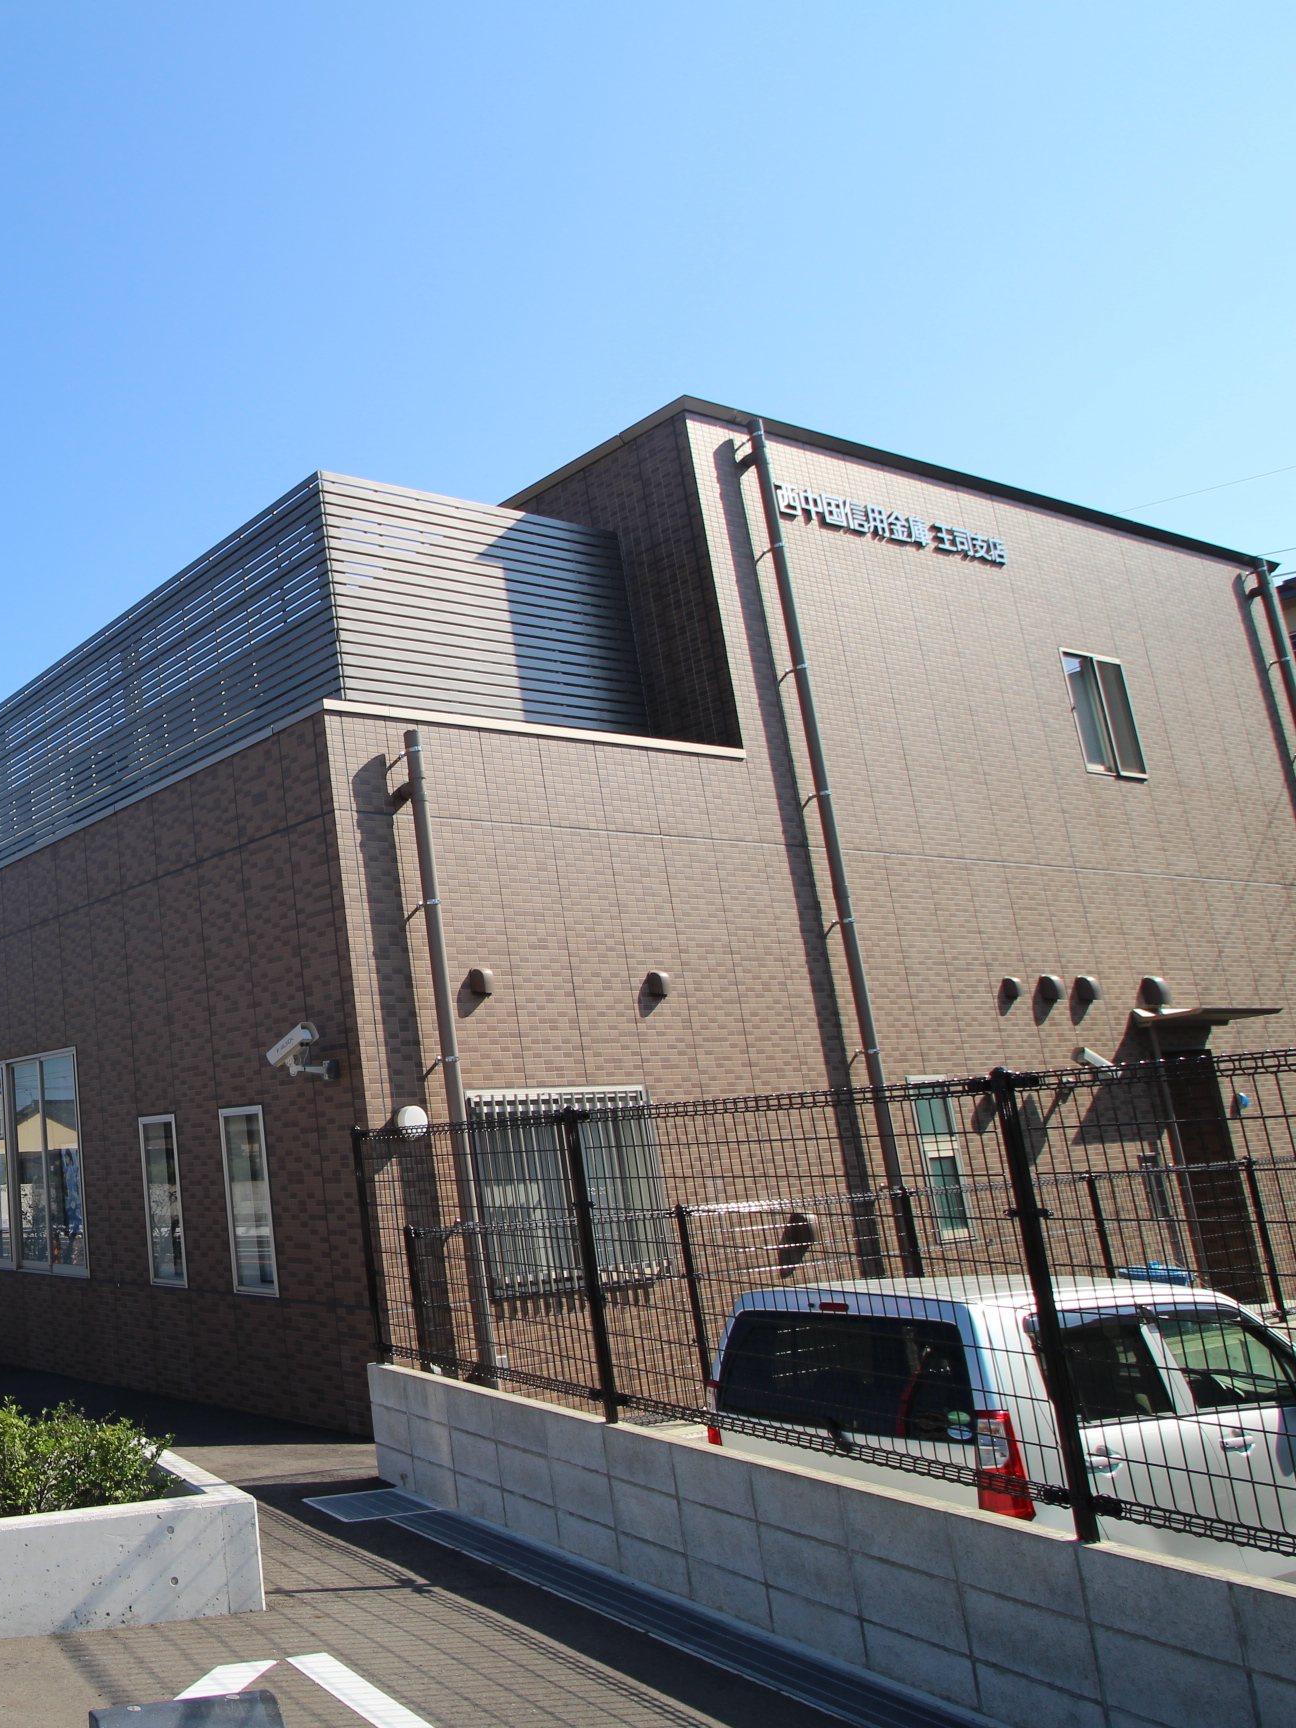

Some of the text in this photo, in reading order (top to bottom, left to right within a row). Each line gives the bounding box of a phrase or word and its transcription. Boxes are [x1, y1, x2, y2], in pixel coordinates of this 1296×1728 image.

[774, 481, 1008, 565] 西中国信用金庫 王司支店
